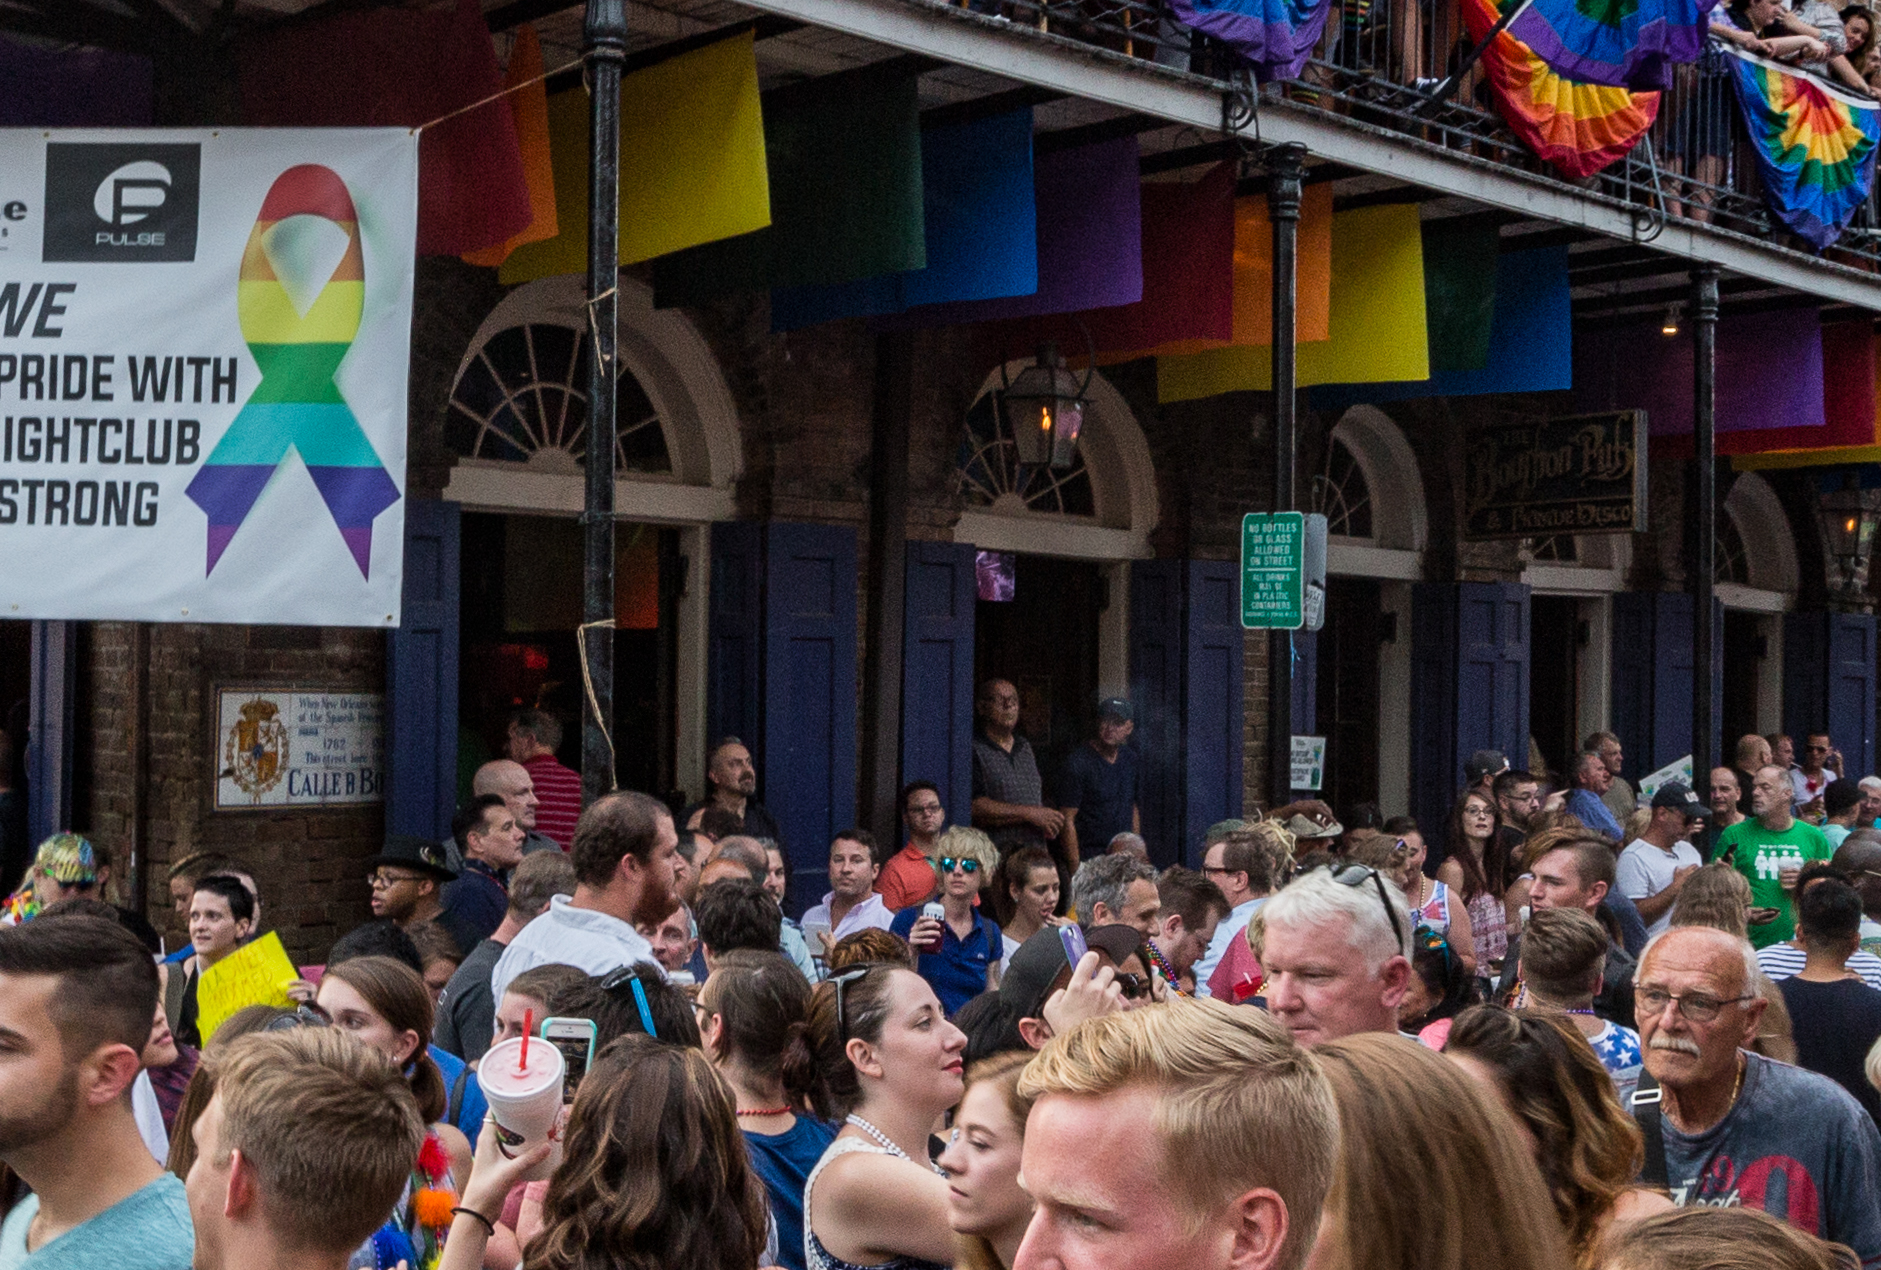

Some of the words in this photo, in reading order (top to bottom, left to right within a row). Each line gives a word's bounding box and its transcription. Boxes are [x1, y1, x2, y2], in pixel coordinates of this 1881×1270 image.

[95, 231, 166, 246] PULSE
[128, 356, 237, 405] WITH
[1248, 524, 1259, 533] NO
[1262, 523, 1297, 533] BOTTLES
[1253, 535, 1263, 544] OR
[1266, 534, 1292, 544] GLASS
[1254, 545, 1290, 555] ALLOWED
[1250, 556, 1261, 566] ON
[1264, 556, 1293, 566] STREET
